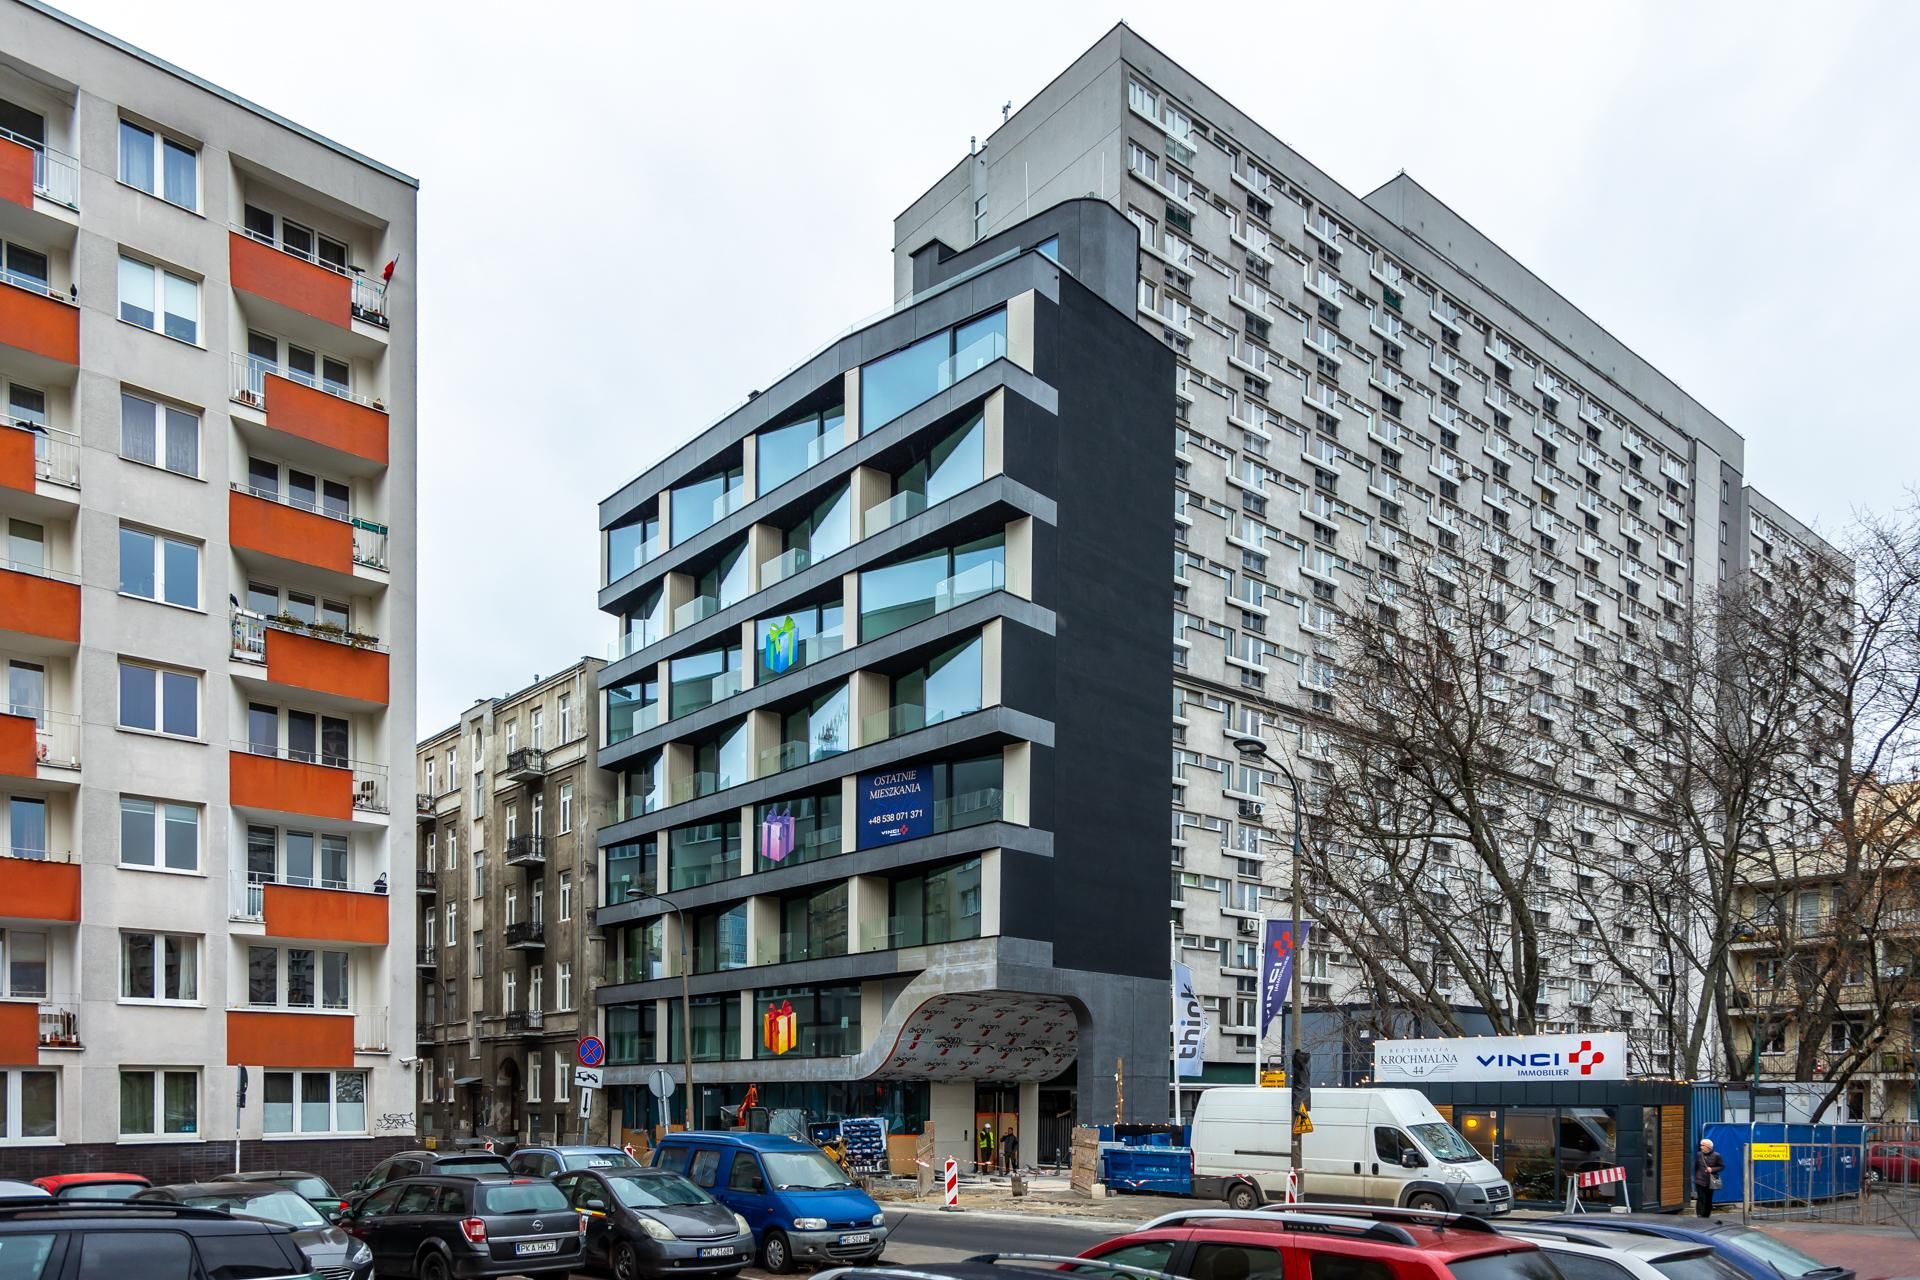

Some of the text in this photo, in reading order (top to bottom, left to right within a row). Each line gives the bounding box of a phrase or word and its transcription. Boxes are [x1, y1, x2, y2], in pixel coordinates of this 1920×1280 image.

[874, 770, 916, 786] OSTATNIE
[870, 783, 920, 799] MIESZKANIA
[868, 810, 923, 825] +48 538 071 371
[1179, 984, 1201, 1058] think
[1380, 1054, 1458, 1064] KROCHMALNA
[1476, 1053, 1559, 1067] VINCI
[1412, 1066, 1424, 1075] 44
[1518, 1069, 1569, 1077] IMMOBILIER
